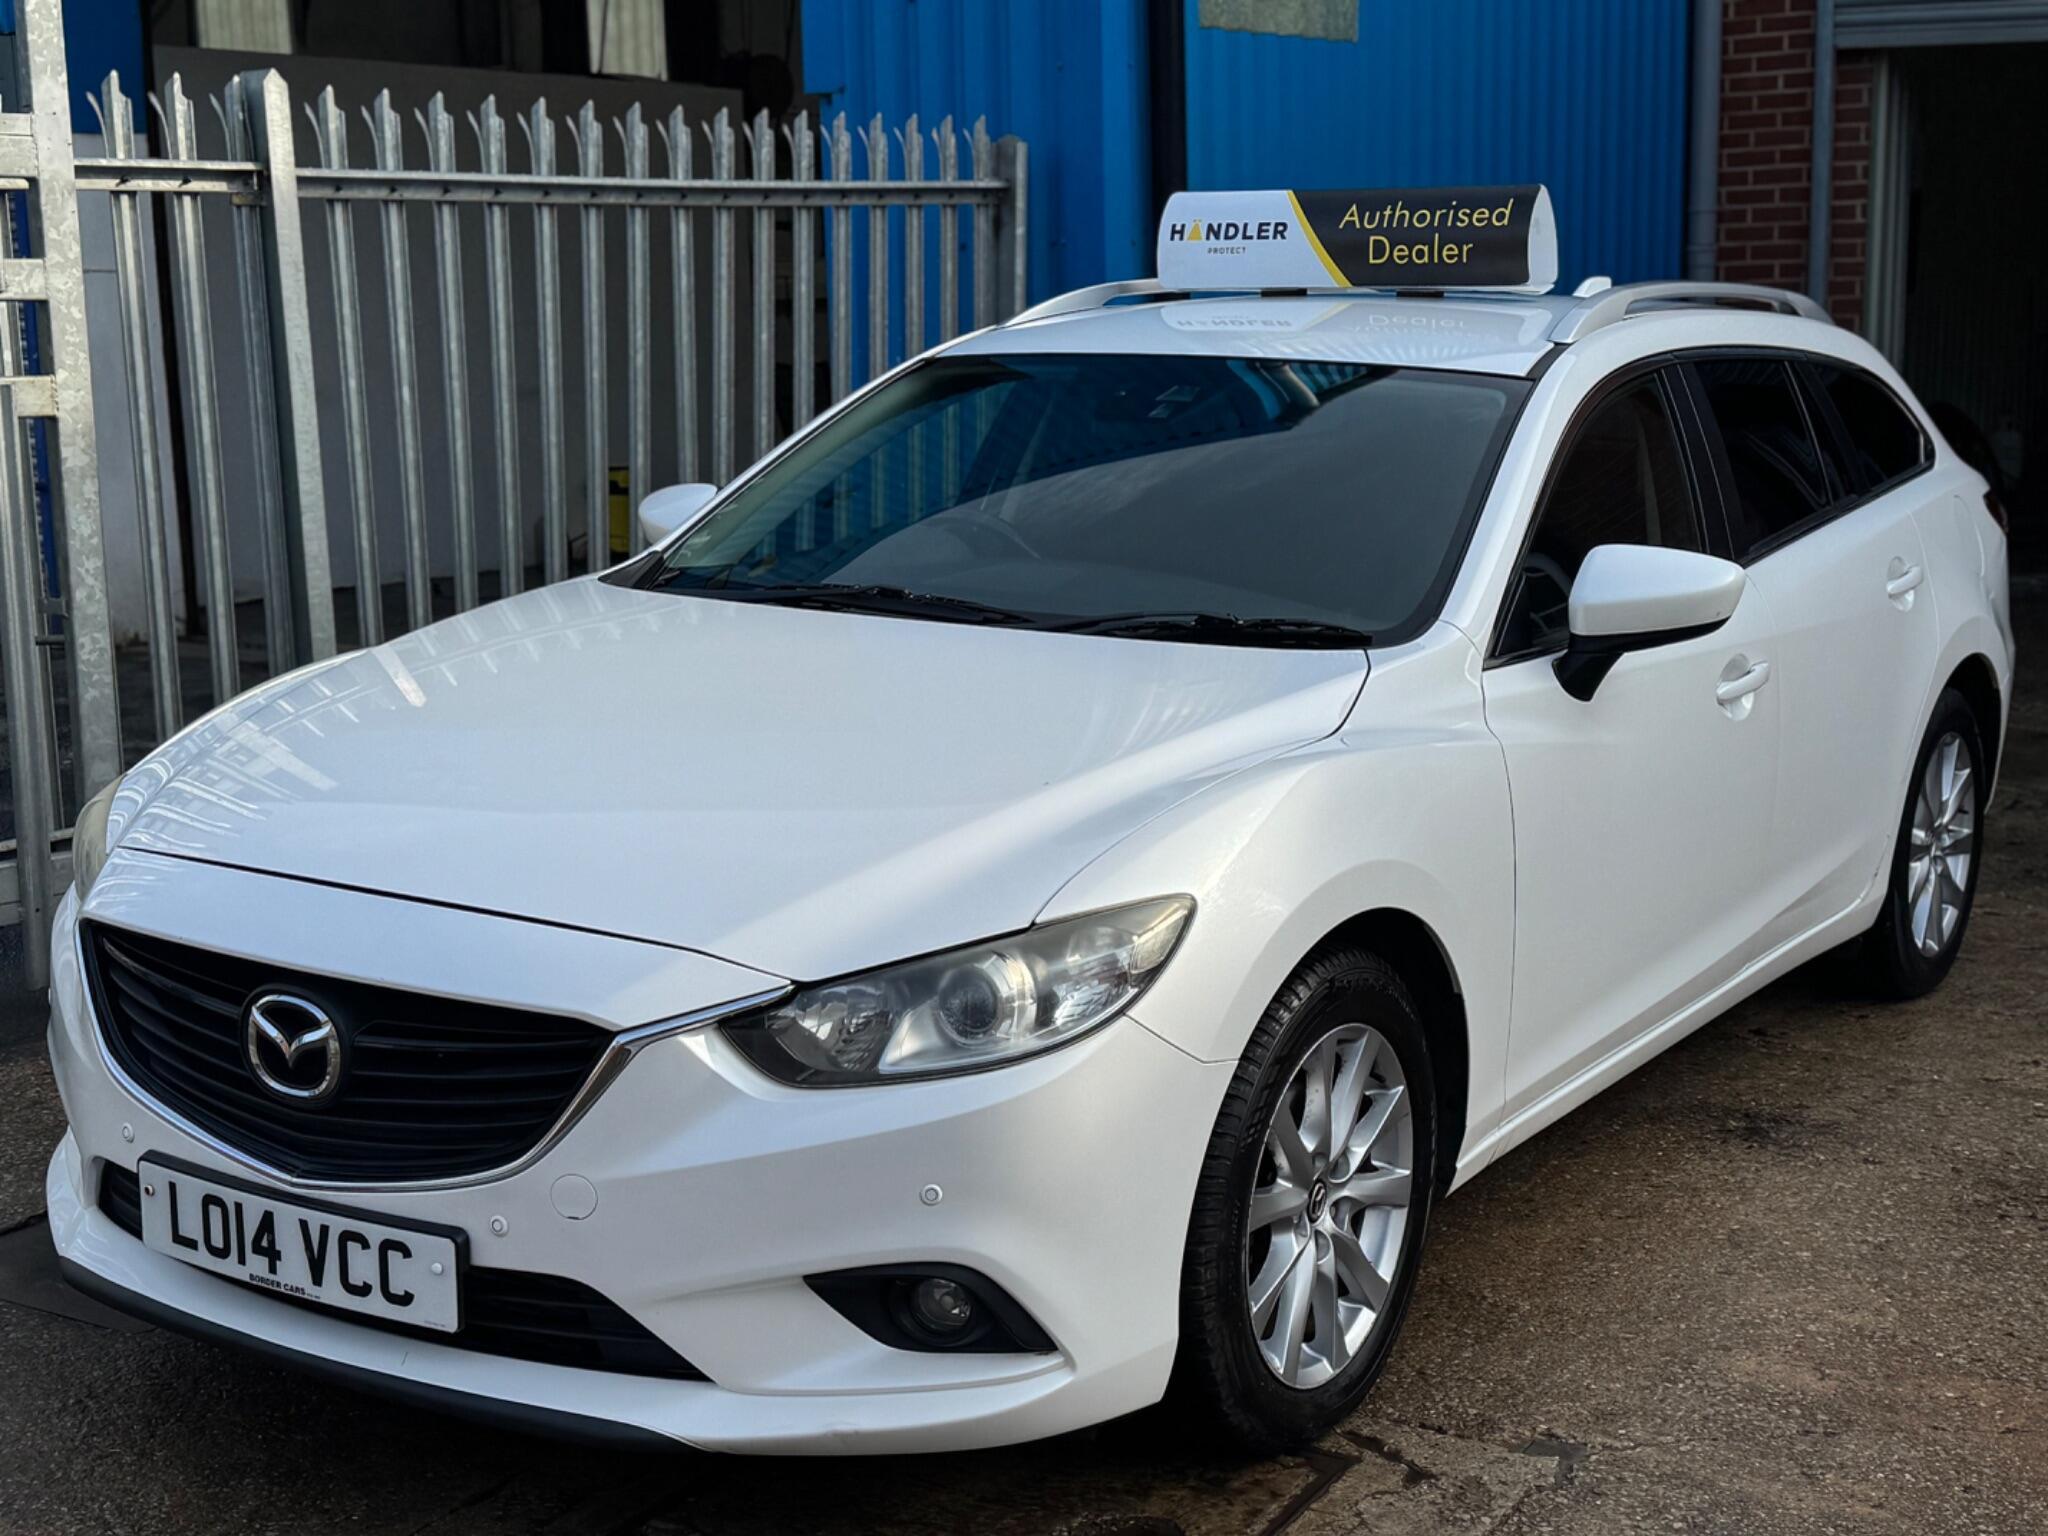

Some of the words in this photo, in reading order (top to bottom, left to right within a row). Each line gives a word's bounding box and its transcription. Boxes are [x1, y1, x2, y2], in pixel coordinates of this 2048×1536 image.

[1339, 198, 1514, 229] Authorised
[1207, 247, 1246, 255] PROTECT
[1368, 236, 1474, 264] Dealer
[168, 1180, 282, 1275] LO14
[298, 1218, 415, 1307] VCC
[249, 1273, 282, 1289] BORDER
[283, 1283, 306, 1296] CARS
